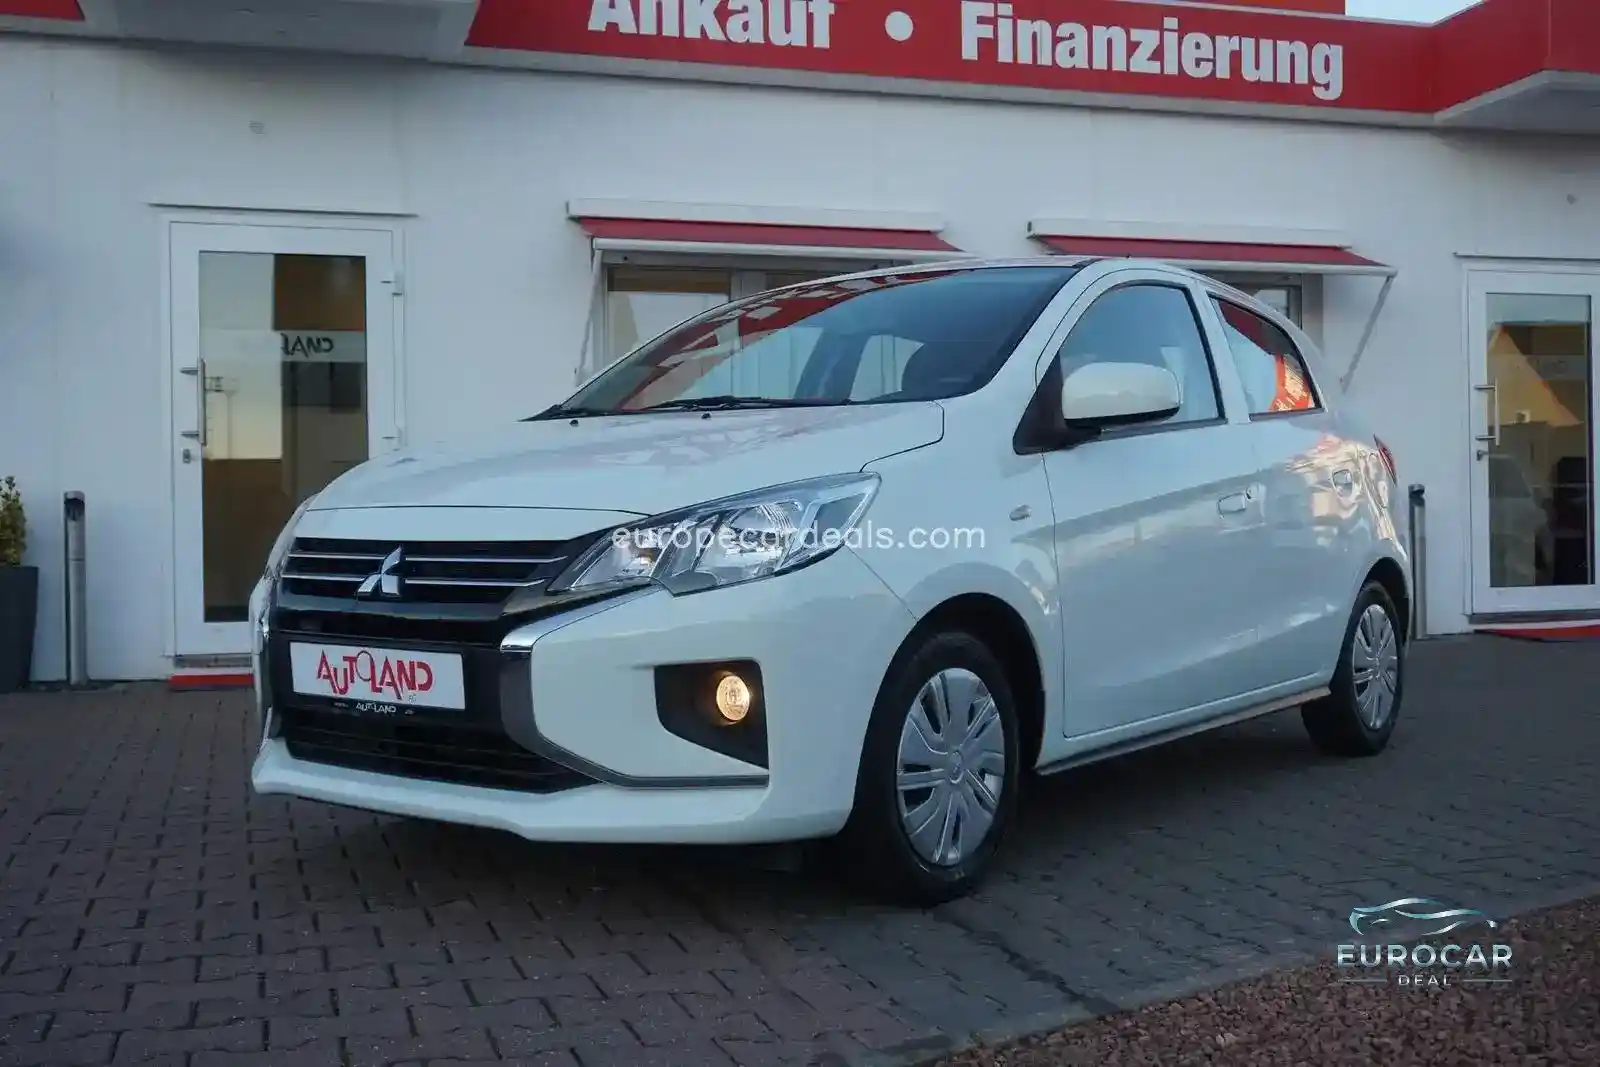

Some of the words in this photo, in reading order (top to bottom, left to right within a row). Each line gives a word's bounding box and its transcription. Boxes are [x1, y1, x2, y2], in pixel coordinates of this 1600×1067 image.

[588, 0, 835, 48] Ankauf
[961, 0, 1344, 101] Finanzierung
[317, 650, 434, 700] AUTOLAND
